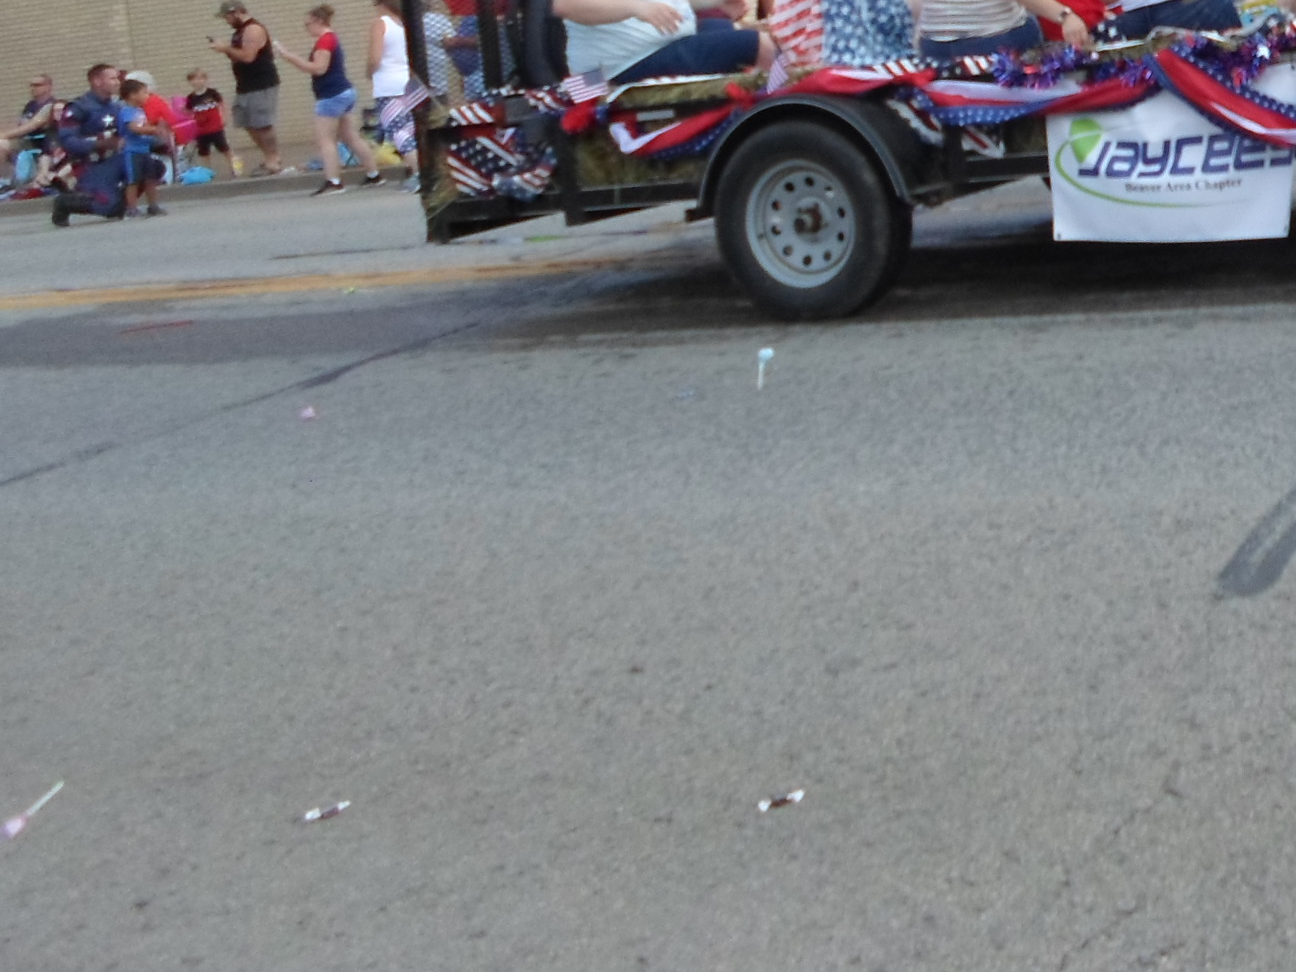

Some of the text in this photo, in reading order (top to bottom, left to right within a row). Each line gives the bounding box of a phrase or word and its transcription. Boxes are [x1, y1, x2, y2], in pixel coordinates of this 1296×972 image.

[1124, 177, 1243, 193] Beaver Area Chapter
